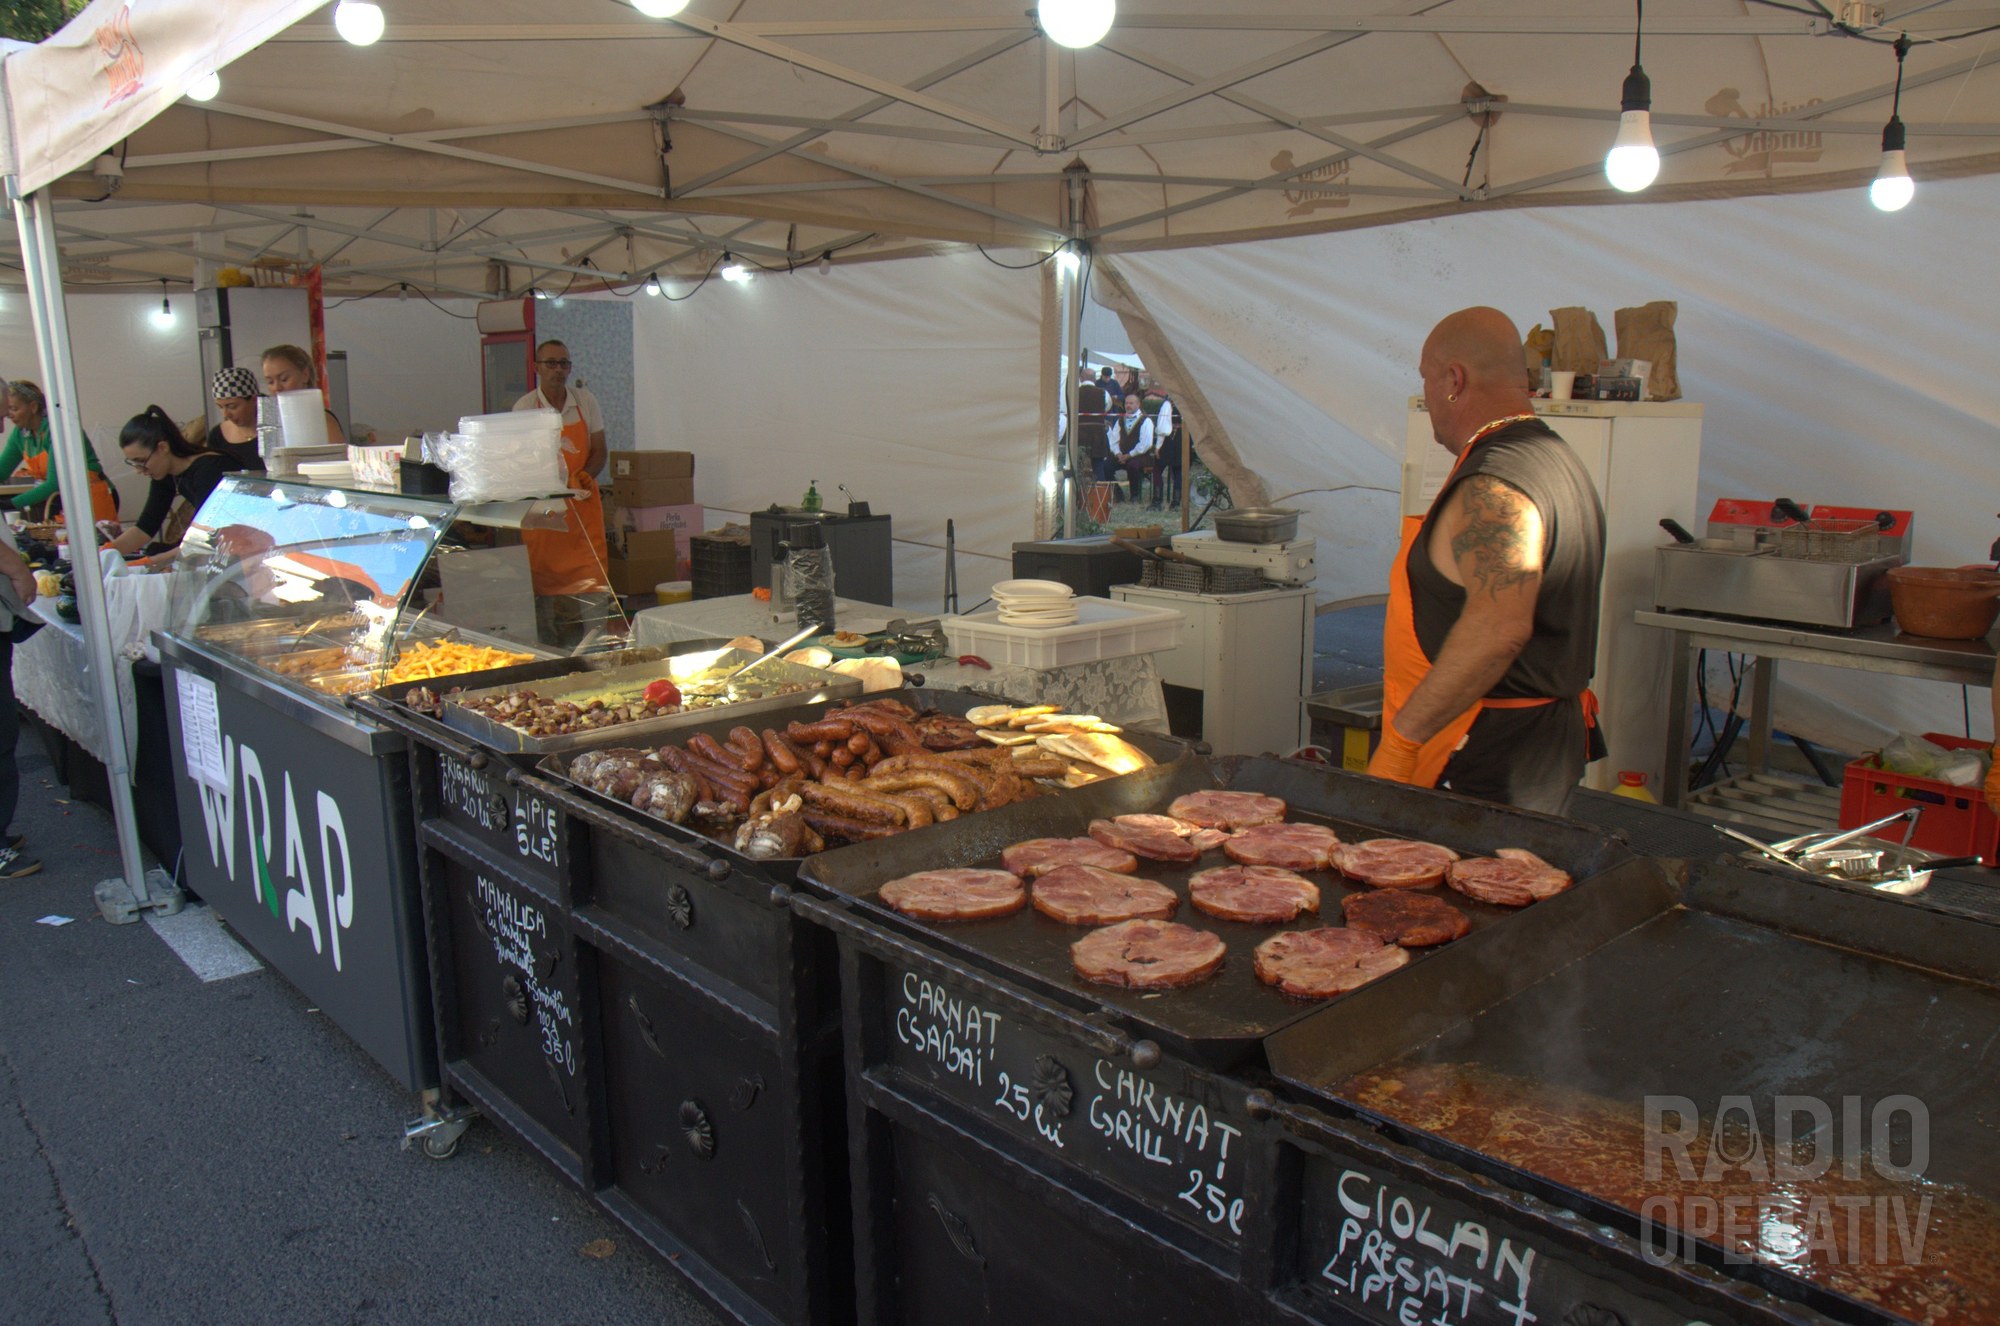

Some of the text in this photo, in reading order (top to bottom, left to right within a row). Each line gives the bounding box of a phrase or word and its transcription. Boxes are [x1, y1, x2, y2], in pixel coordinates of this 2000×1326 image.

[198, 734, 354, 973] WRAP
[1337, 1169, 1536, 1300] CIOLAN
[1339, 1218, 1485, 1319] PRESAT
